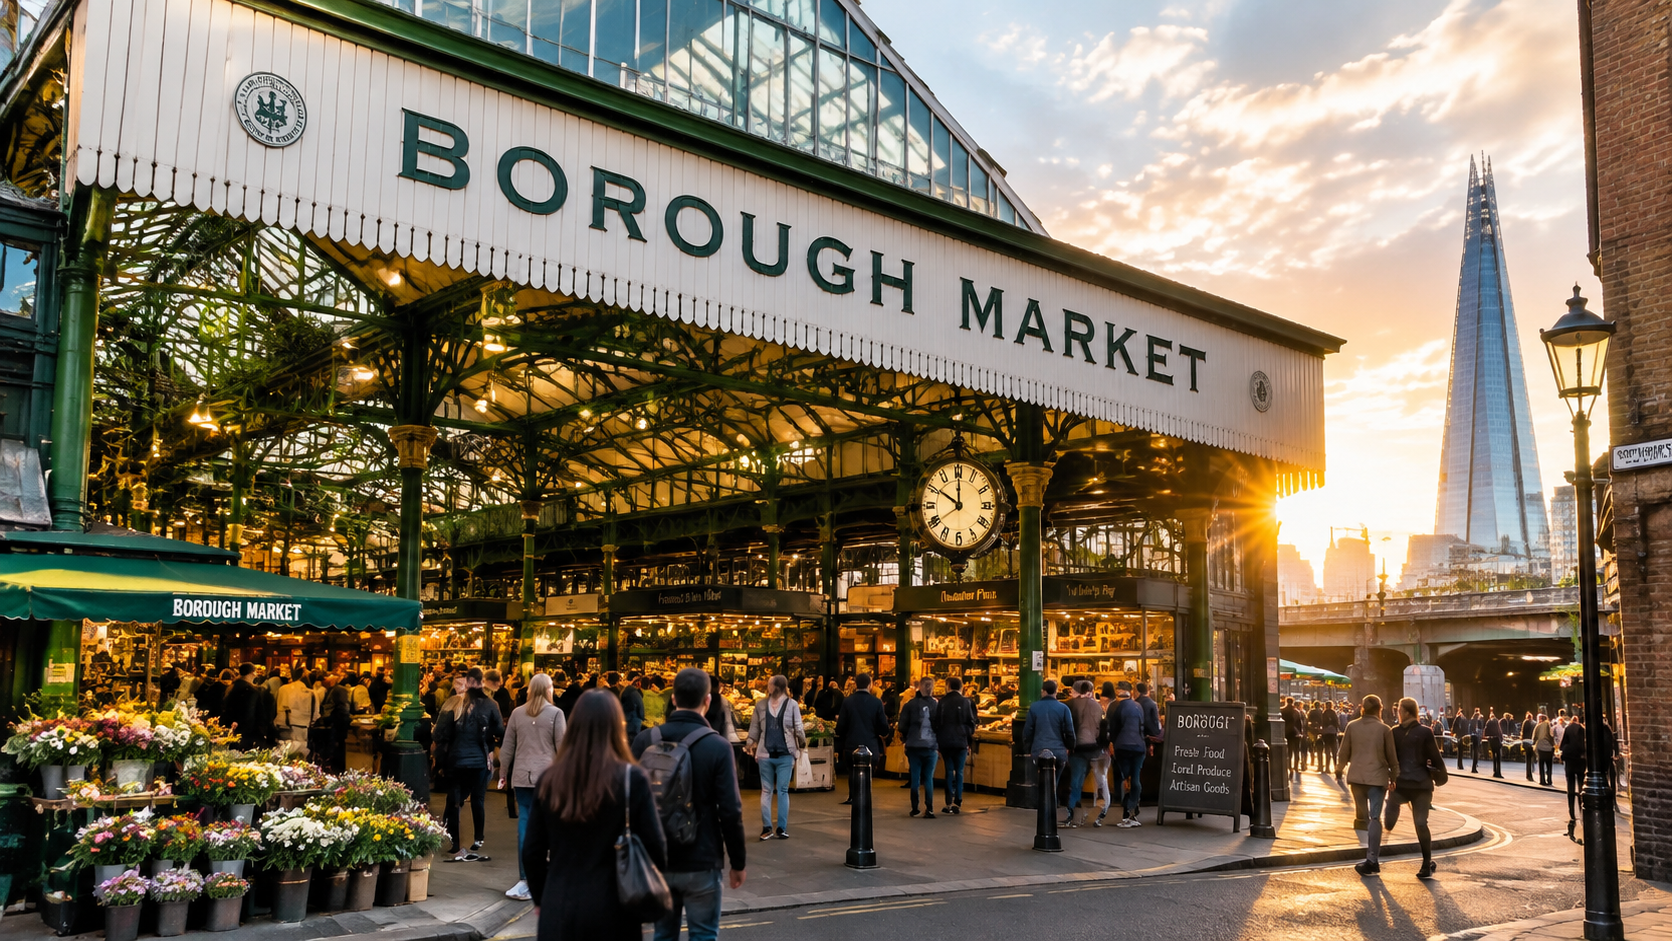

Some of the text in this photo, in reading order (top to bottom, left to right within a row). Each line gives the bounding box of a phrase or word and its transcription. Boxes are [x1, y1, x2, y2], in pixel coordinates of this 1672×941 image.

[397, 107, 916, 316] BOROUGH
[959, 276, 1208, 394] MARKET
[172, 598, 302, 621] BOROUGH MARKET
[1203, 746, 1226, 759] Food
[1197, 764, 1232, 778] Produce
[1169, 779, 1230, 795] Artisan Goods
